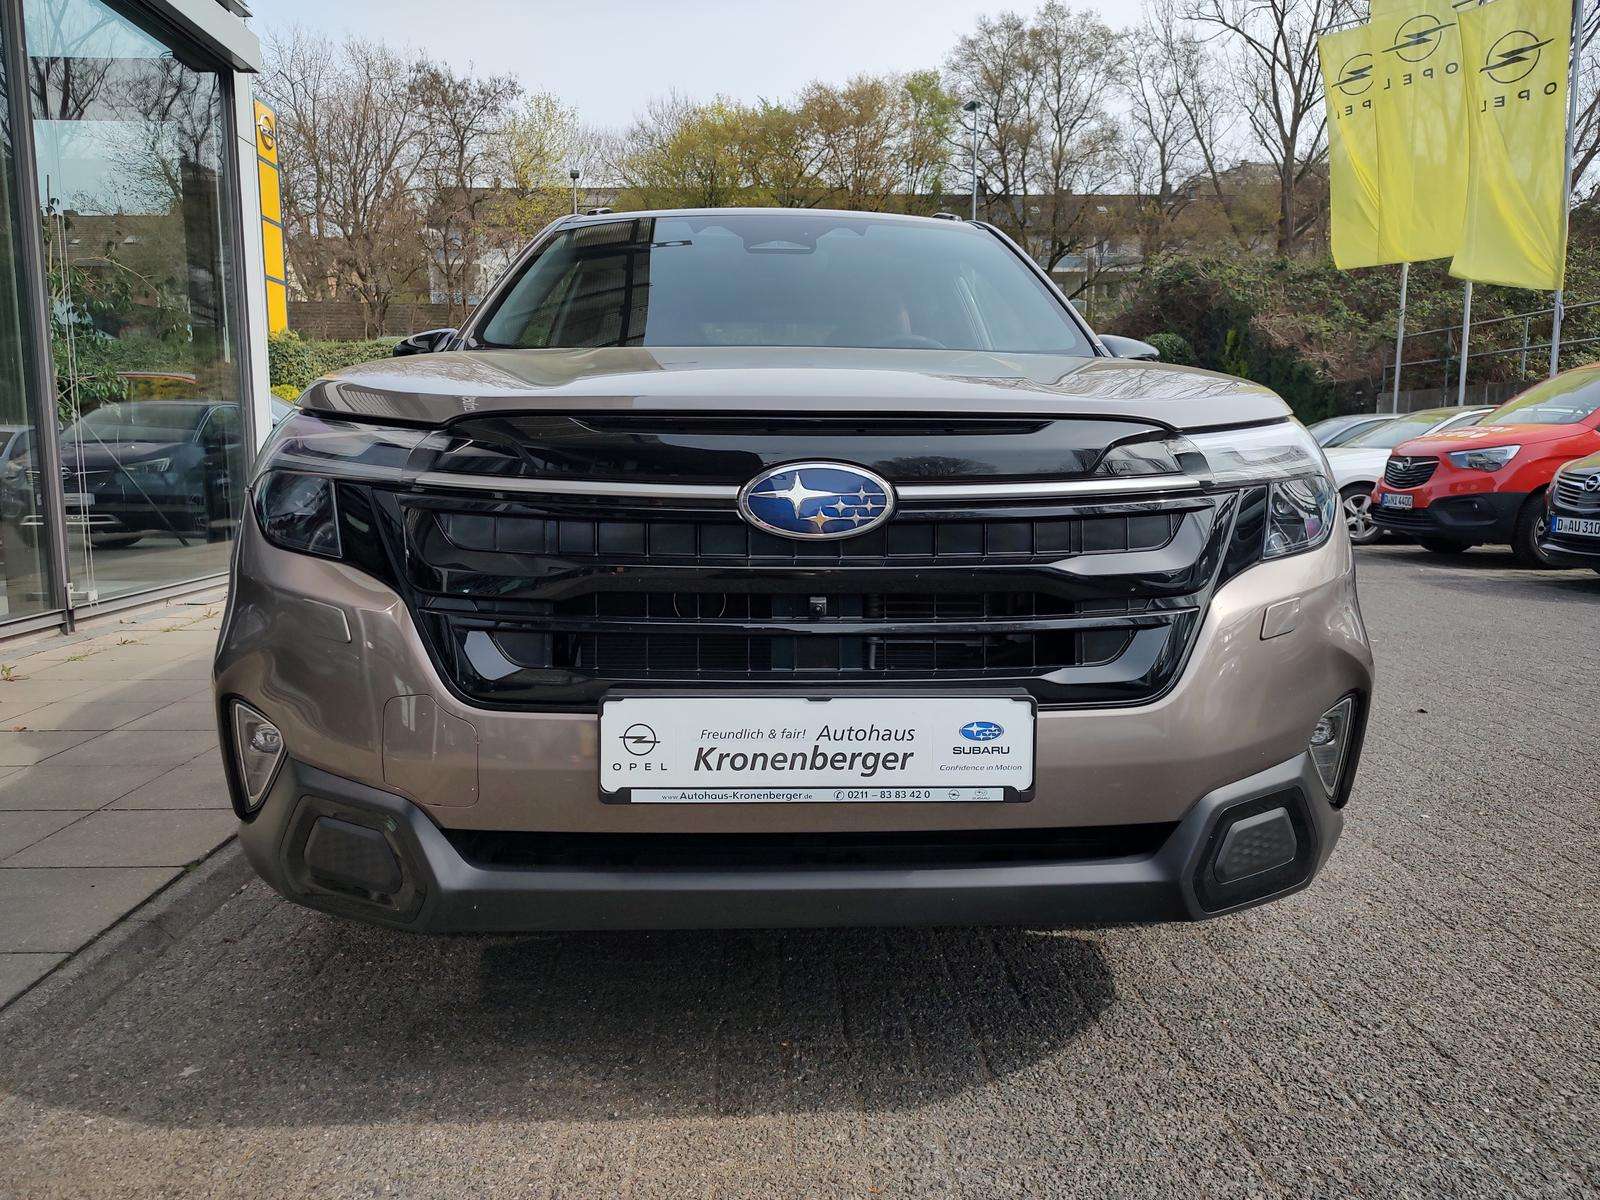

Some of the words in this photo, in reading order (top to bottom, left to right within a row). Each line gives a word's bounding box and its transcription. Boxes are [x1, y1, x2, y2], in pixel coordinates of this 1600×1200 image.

[1557, 519, 1564, 531] D
[1569, 520, 1580, 532] AU
[700, 729, 764, 740] Freundlich
[768, 729, 777, 739] &
[780, 728, 807, 741] fair!
[816, 724, 915, 742] Autohaus
[952, 746, 1010, 755] SUBARU
[612, 762, 668, 771] OPEL
[694, 745, 914, 777] Kronenberger
[847, 790, 868, 799] 0211
[880, 790, 891, 799] 83
[894, 790, 906, 799] 83
[909, 790, 921, 799] 42
[924, 790, 931, 799] 0
